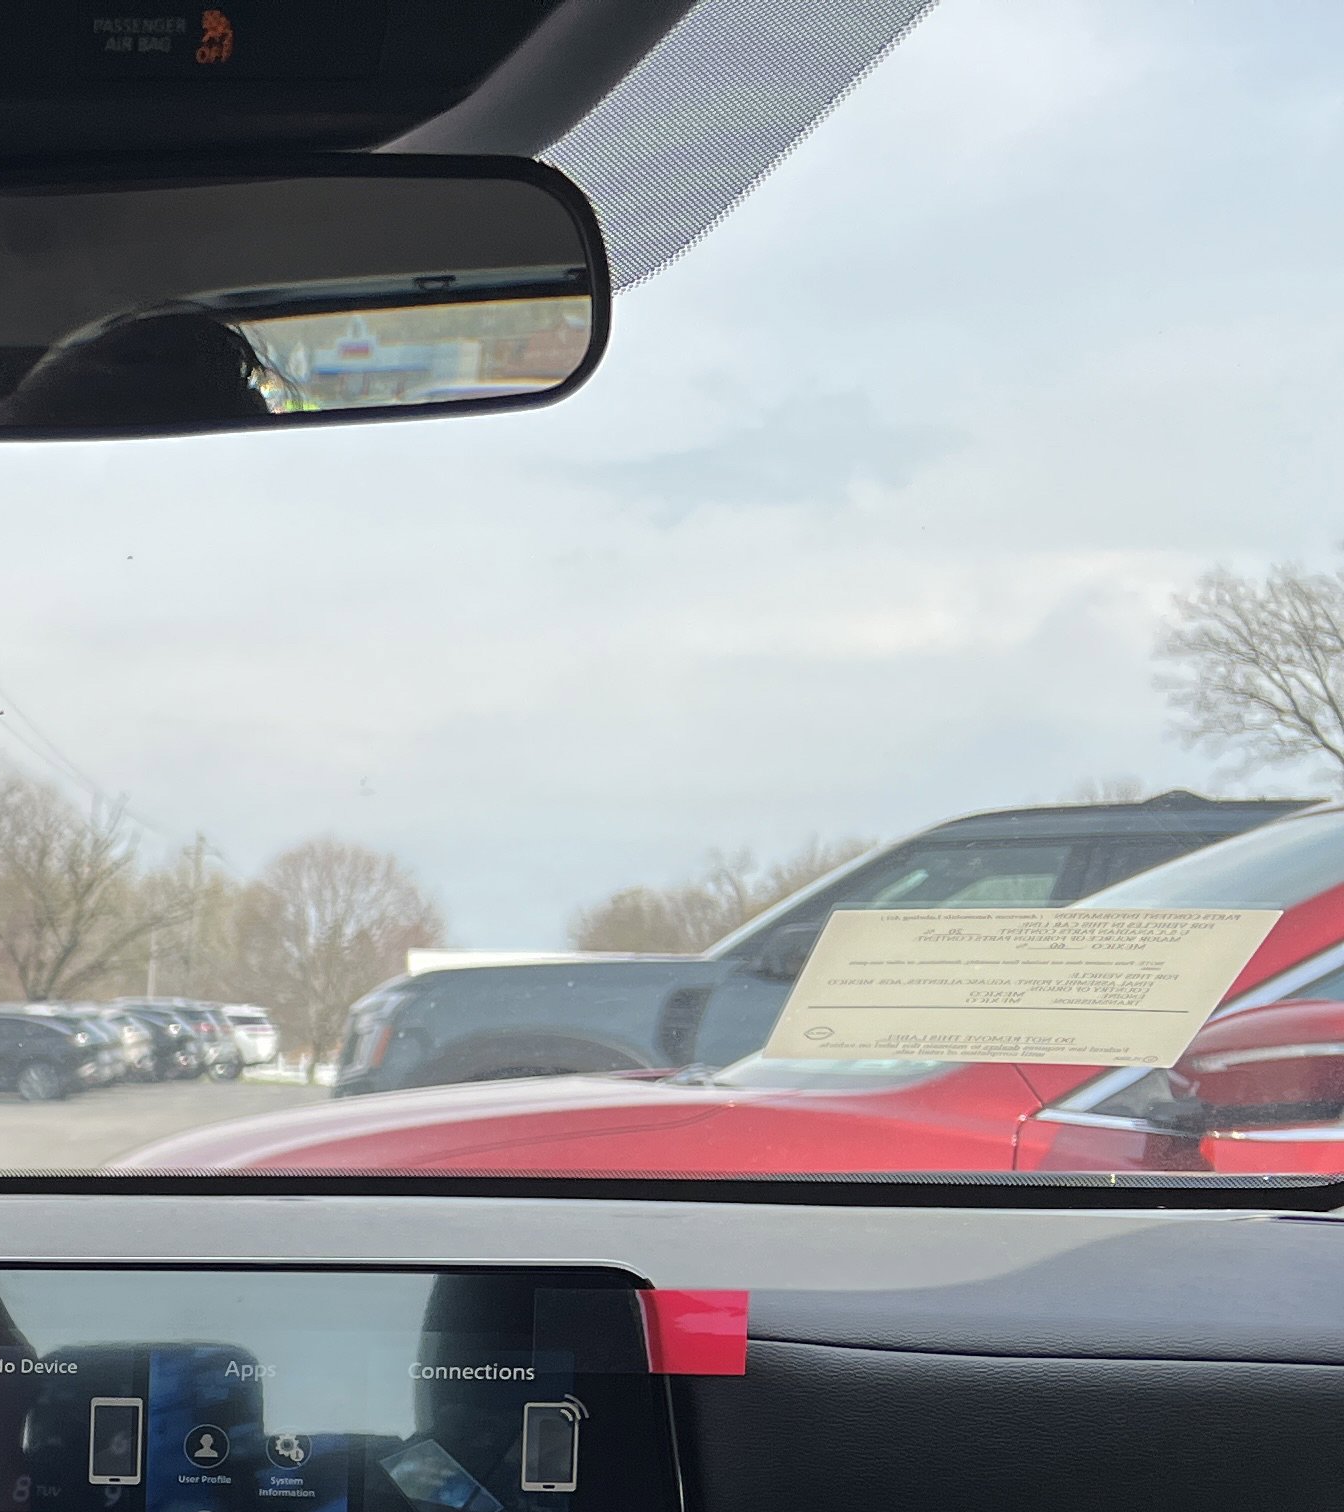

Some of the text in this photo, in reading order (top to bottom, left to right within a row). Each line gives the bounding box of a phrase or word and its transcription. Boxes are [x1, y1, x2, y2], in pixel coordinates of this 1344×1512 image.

[19, 1358, 79, 1375] Device
[224, 1359, 278, 1382] Apps
[407, 1361, 536, 1382] Connections
[178, 1475, 232, 1484] User Profile
[270, 1476, 304, 1486] System
[258, 1488, 316, 1498] Information
